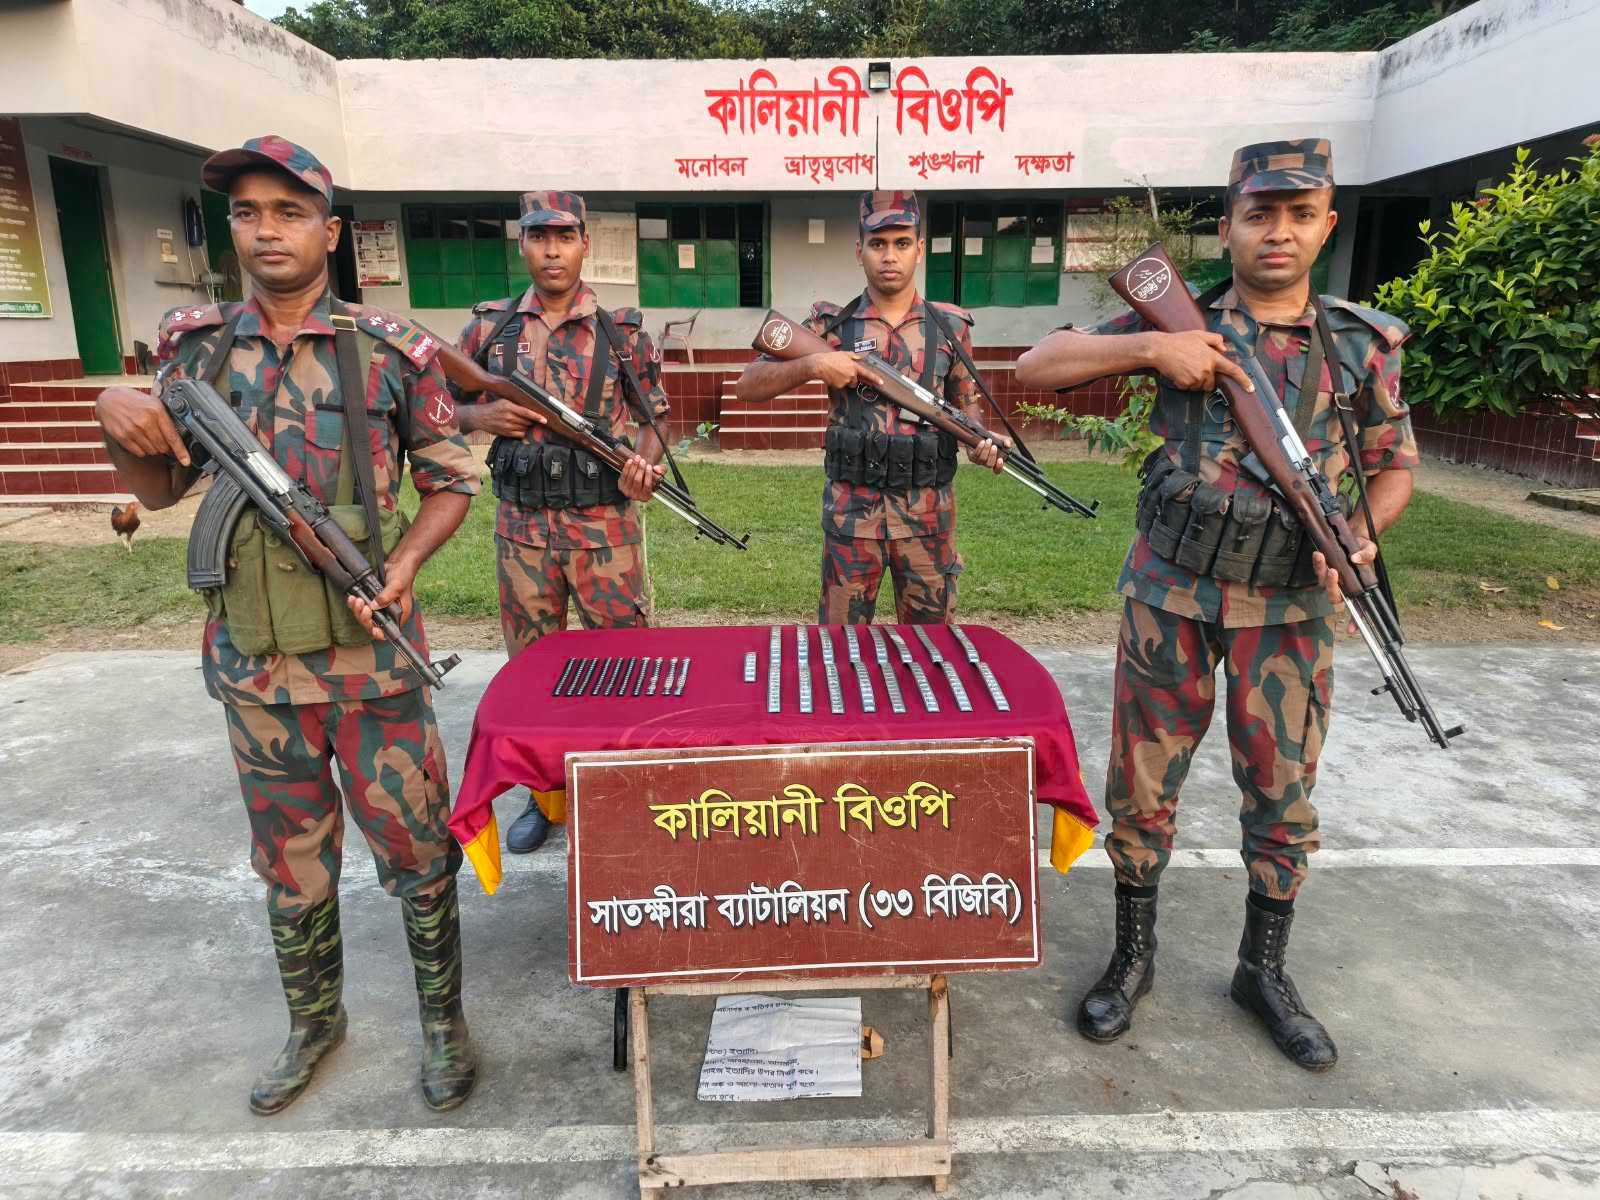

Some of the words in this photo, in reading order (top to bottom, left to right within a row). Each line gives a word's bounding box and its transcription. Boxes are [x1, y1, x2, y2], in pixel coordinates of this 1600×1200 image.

[704, 65, 869, 138] কালিয়ানী
[890, 66, 1013, 136] বিওপি
[674, 153, 749, 178] মনোবল
[1014, 151, 1075, 176] দক্ষতা
[648, 783, 825, 841] কালিয়ানী
[832, 781, 956, 833] বিওপি
[587, 884, 710, 934] সাতক্ষীরা
[714, 880, 850, 927] ব্যাটালিয়ন
[858, 881, 914, 929] (৩৩
[920, 872, 1022, 925] বিজিবি)
